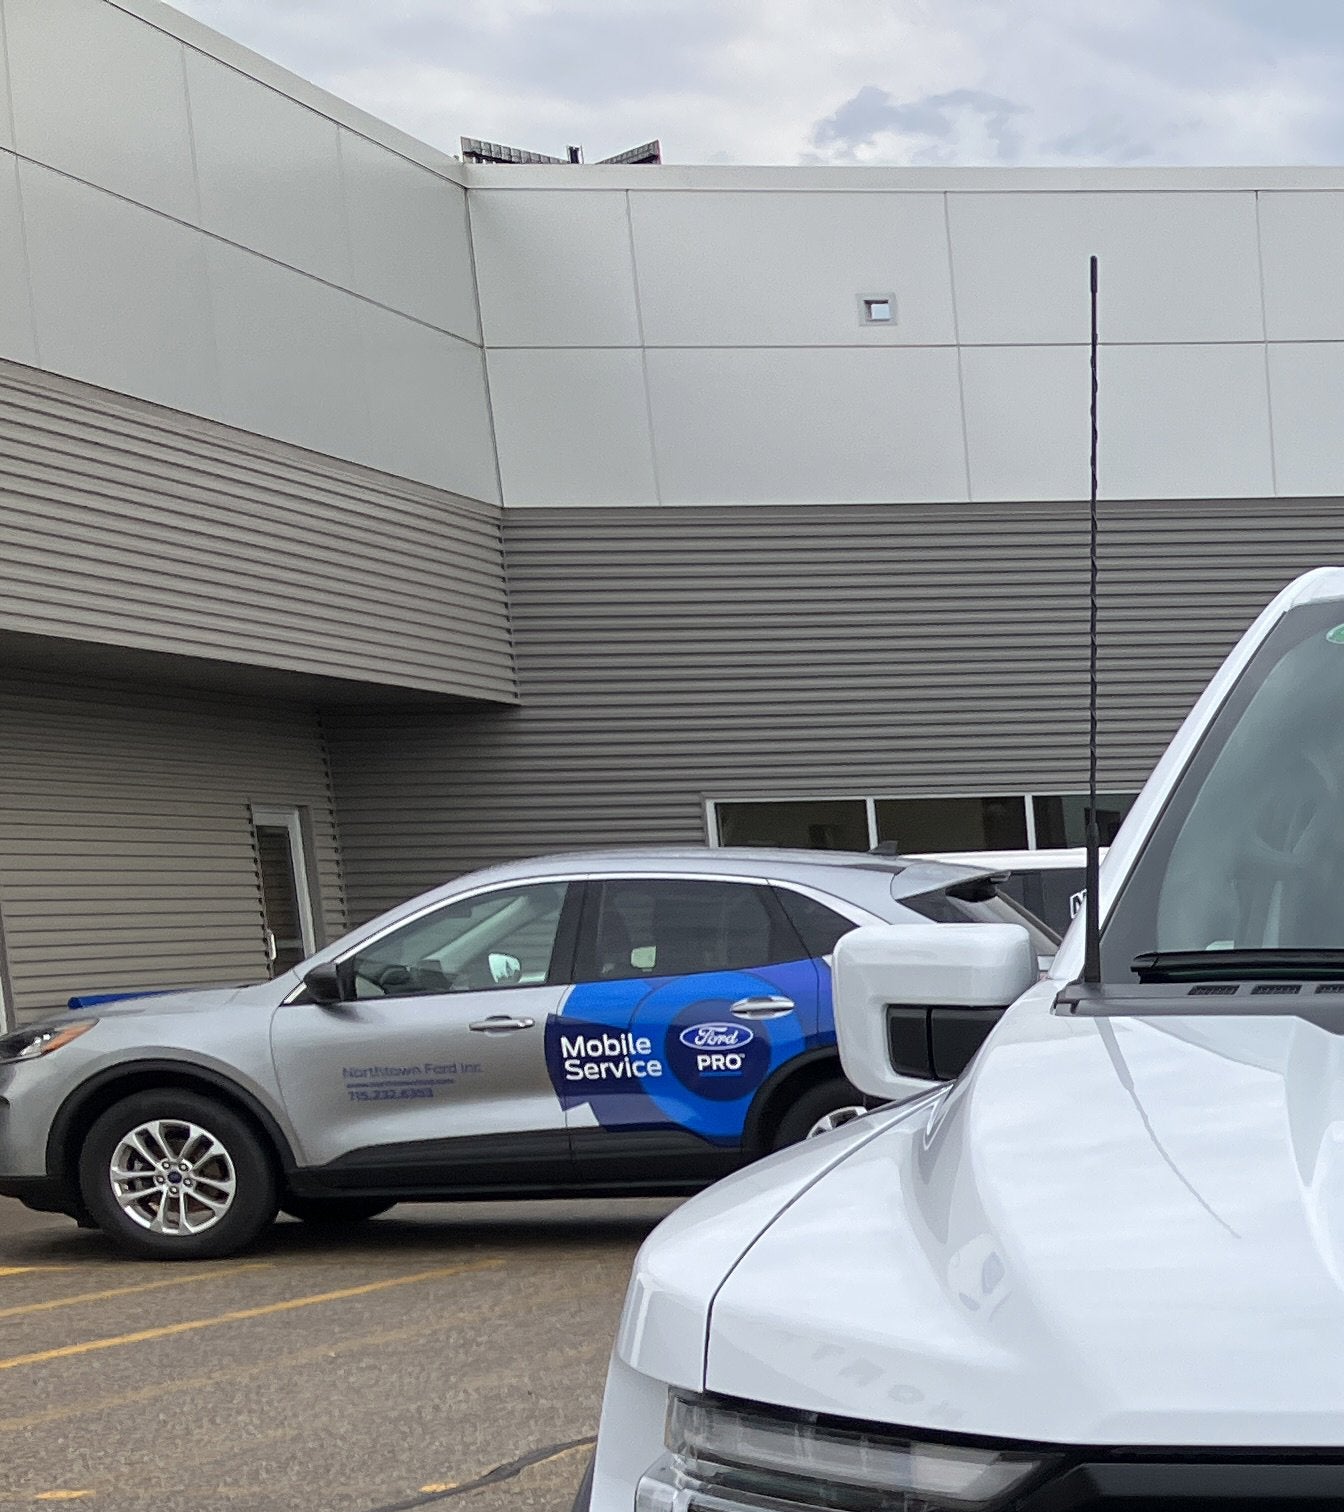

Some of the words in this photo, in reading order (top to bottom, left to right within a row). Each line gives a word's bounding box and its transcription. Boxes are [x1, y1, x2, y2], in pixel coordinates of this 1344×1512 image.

[560, 1033, 652, 1058] Mobile
[694, 1027, 739, 1046] Ford
[564, 1057, 662, 1080] Service
